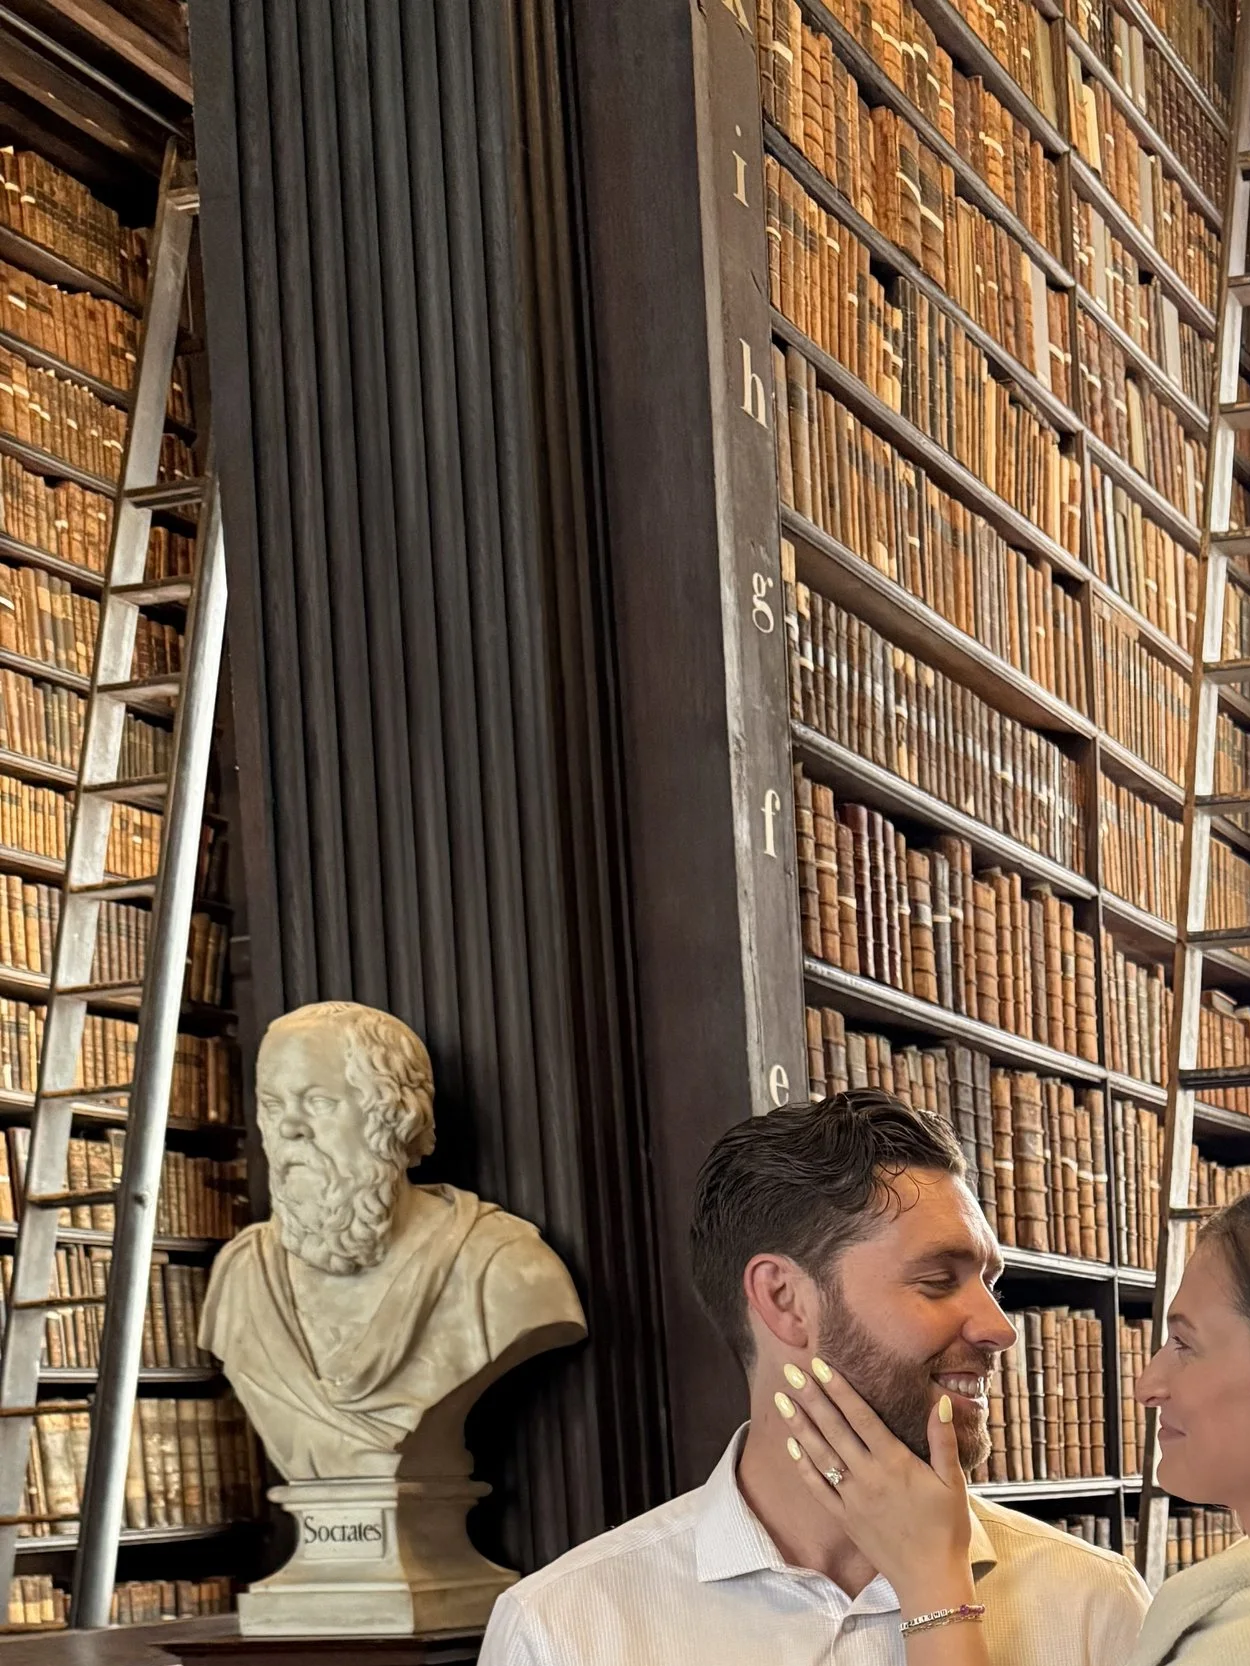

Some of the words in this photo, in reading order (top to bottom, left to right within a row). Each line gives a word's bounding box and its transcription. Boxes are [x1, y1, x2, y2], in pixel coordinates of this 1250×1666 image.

[731, 123, 750, 208] i
[739, 338, 768, 429] h
[752, 571, 775, 634] g
[760, 789, 781, 858] f
[769, 1064, 790, 1108] e
[303, 1516, 382, 1545] Socrates
